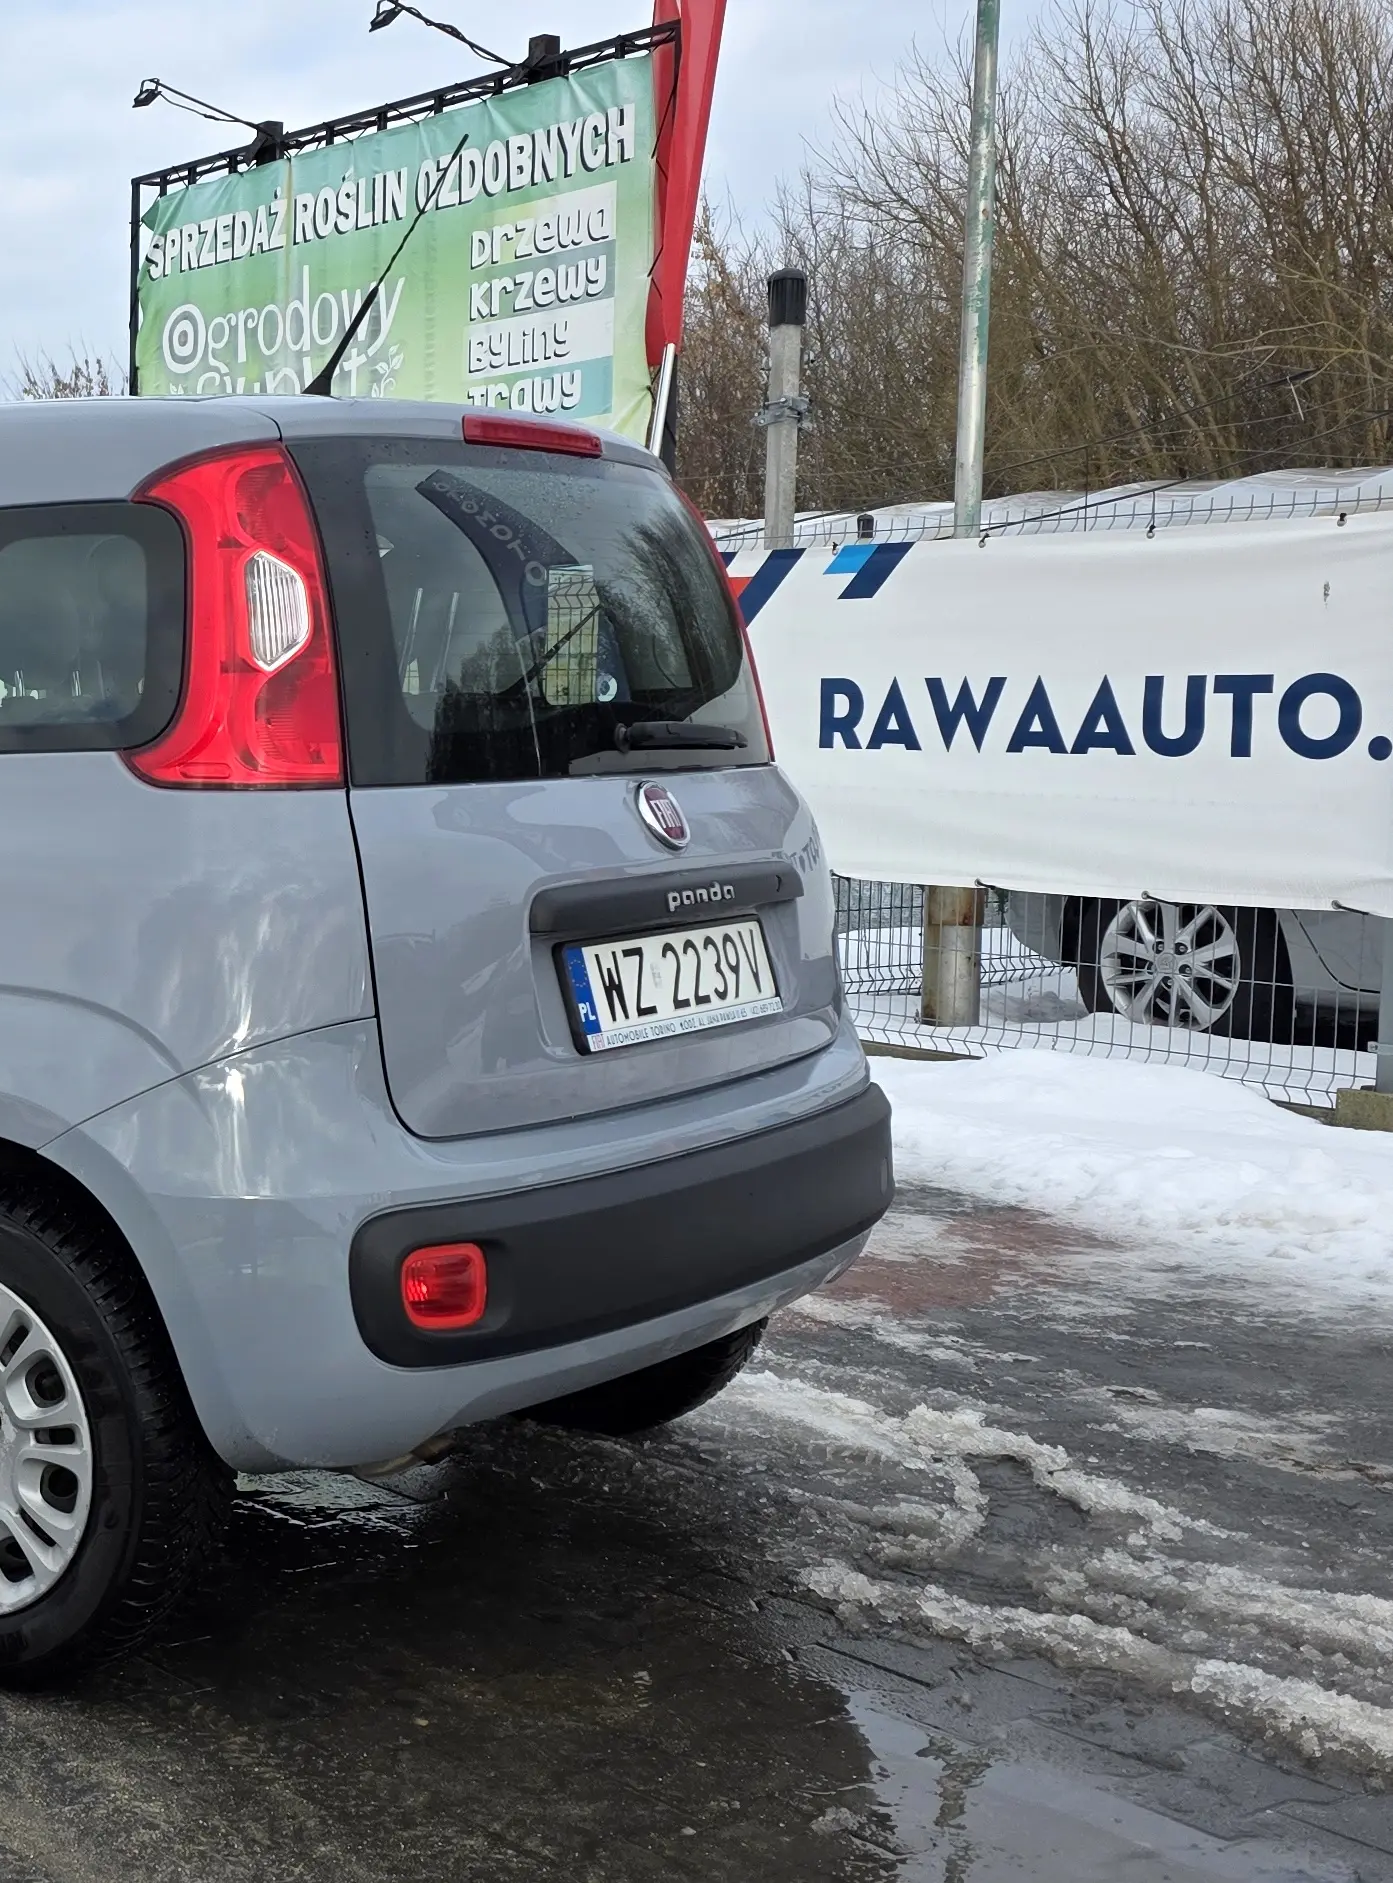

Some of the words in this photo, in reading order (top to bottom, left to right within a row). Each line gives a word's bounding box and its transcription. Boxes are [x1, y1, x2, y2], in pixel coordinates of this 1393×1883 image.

[145, 186, 287, 281] SPRZEDAŻ
[292, 167, 407, 245] ROŚLIN
[415, 103, 636, 212] OZDOBNYCH
[162, 265, 405, 374] Ogrodowy
[818, 673, 1393, 761] RAWAAUTO.
[650, 799, 682, 829] FIAT
[667, 881, 735, 912] panda
[594, 946, 659, 1023] WZ
[661, 928, 762, 1011] 2239V
[579, 1003, 596, 1023] PL
[607, 1027, 649, 1046] AUTOMOBILE
